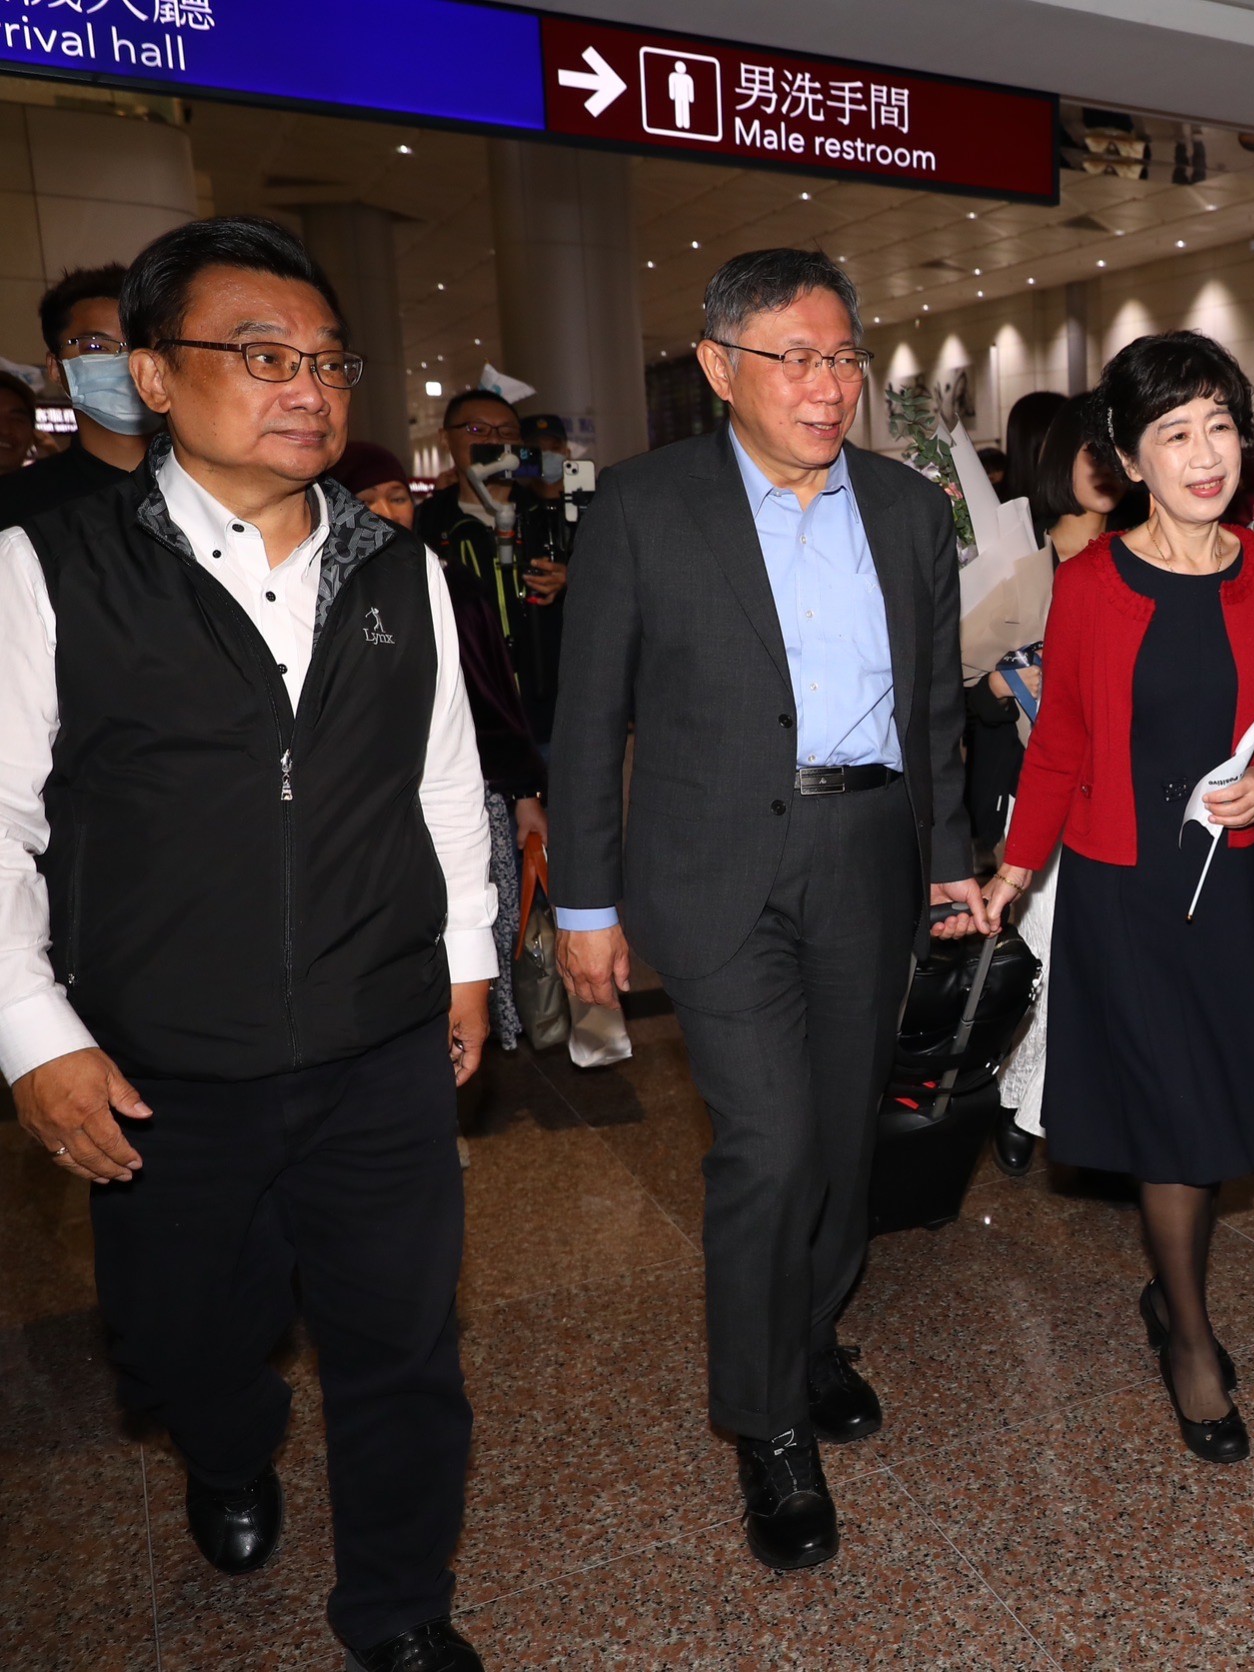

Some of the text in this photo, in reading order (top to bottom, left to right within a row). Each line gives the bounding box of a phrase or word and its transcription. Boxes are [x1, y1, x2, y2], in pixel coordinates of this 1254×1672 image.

[0, 15, 186, 71] rival hall
[735, 62, 909, 134] 男洗手間
[735, 117, 936, 171] Male restroom
[363, 628, 395, 645] Lynx
